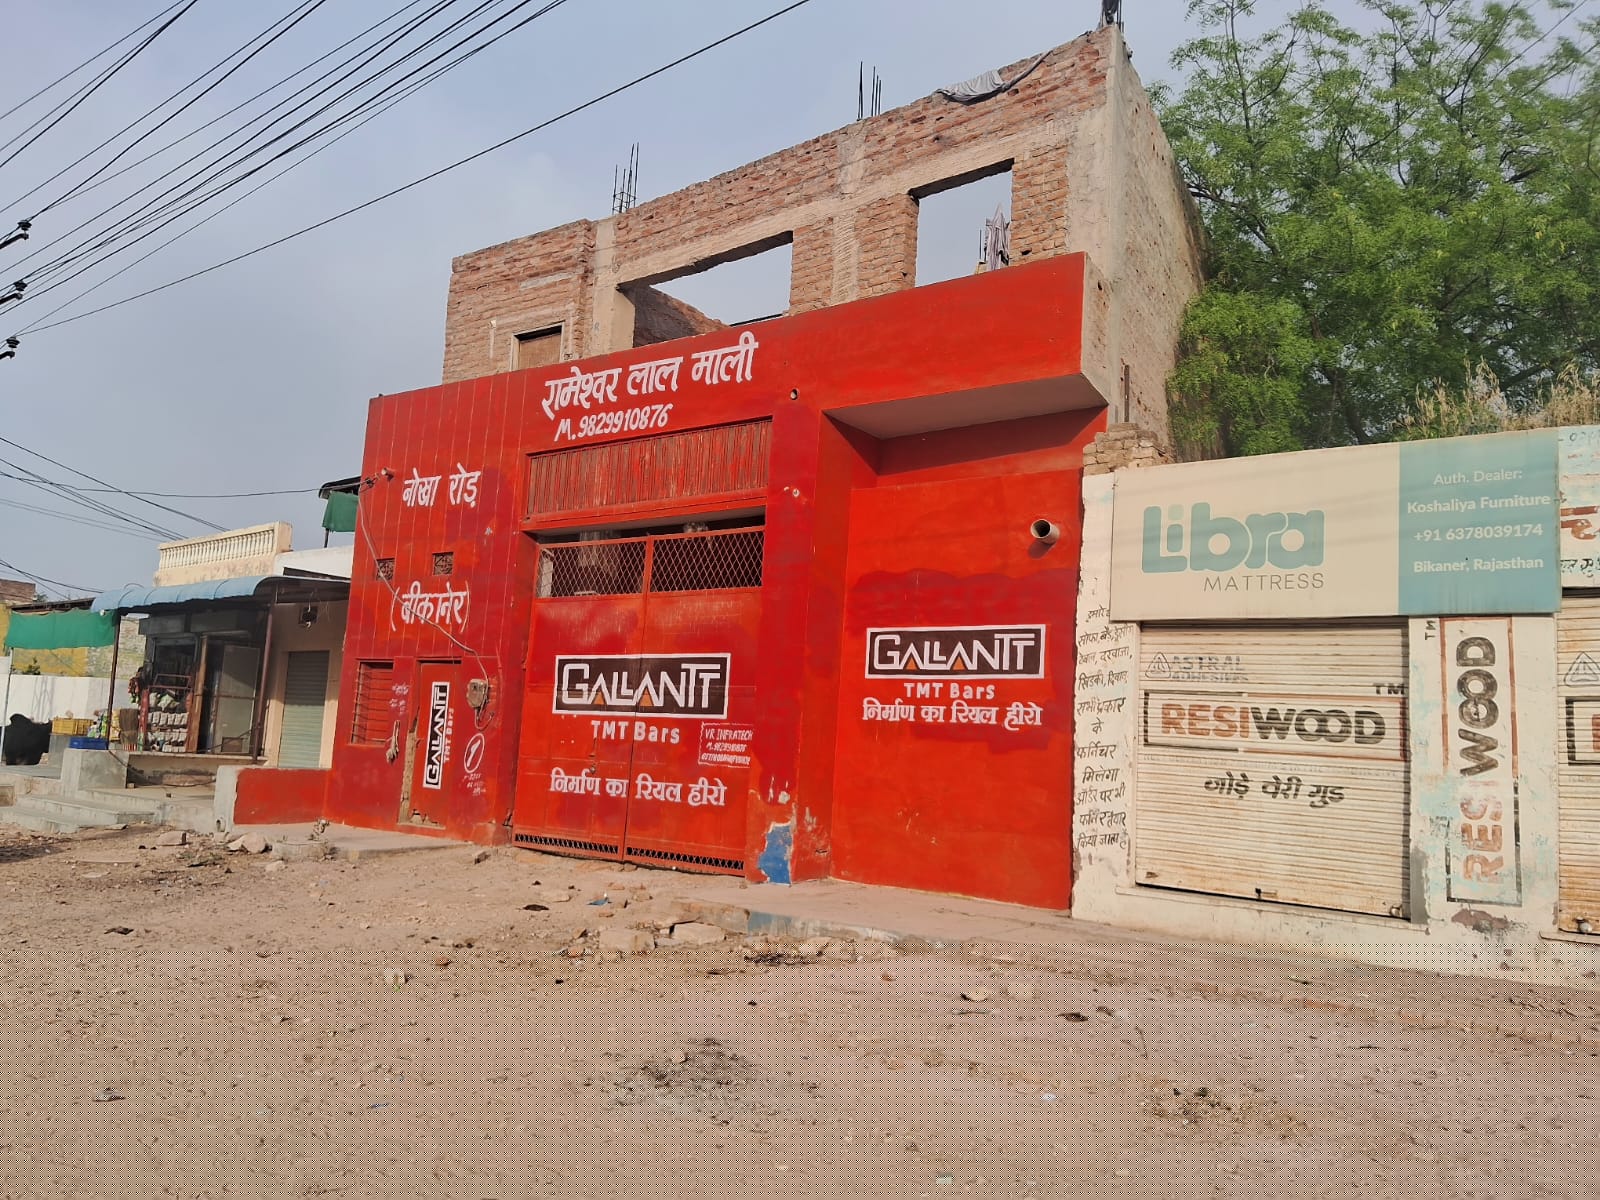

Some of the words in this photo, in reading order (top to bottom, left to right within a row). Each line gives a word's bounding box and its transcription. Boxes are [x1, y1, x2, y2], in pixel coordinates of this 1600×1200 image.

[542, 366, 622, 420] रामेश्वर
[627, 356, 683, 395] लाल
[691, 331, 759, 385] माली
[554, 404, 673, 441] M.9829910876
[402, 468, 442, 507] नोखा
[1433, 473, 1469, 485] Auth.
[1473, 469, 1523, 482] Dealer:
[1407, 499, 1476, 513] Koshaliya
[1480, 495, 1551, 509] Furniture
[1142, 502, 1325, 573] Libra
[1413, 529, 1441, 542] +91
[1446, 524, 1543, 540] 6378039174
[1413, 560, 1470, 573] Bikaner,
[1473, 557, 1544, 572] Rajasthan
[1203, 572, 1325, 593] MATTRESS
[874, 633, 1035, 670] GALLANTT
[562, 663, 721, 708] GALLANTT
[904, 682, 943, 698] TMT
[950, 683, 995, 700] Bars
[1373, 682, 1407, 695] TM
[862, 697, 915, 721] निर्माण
[921, 705, 946, 723] का
[950, 700, 999, 724] रियल
[1004, 701, 1043, 731] हीरो
[1091, 717, 1104, 734] के
[1161, 703, 1386, 744] RESIWOOD
[426, 685, 447, 784] GALLANTT
[591, 720, 628, 740] TMT
[634, 722, 680, 744] Bars
[550, 767, 600, 795] निर्माण
[605, 779, 629, 798] का
[635, 773, 682, 803] रियल
[687, 777, 728, 806] हीरो
